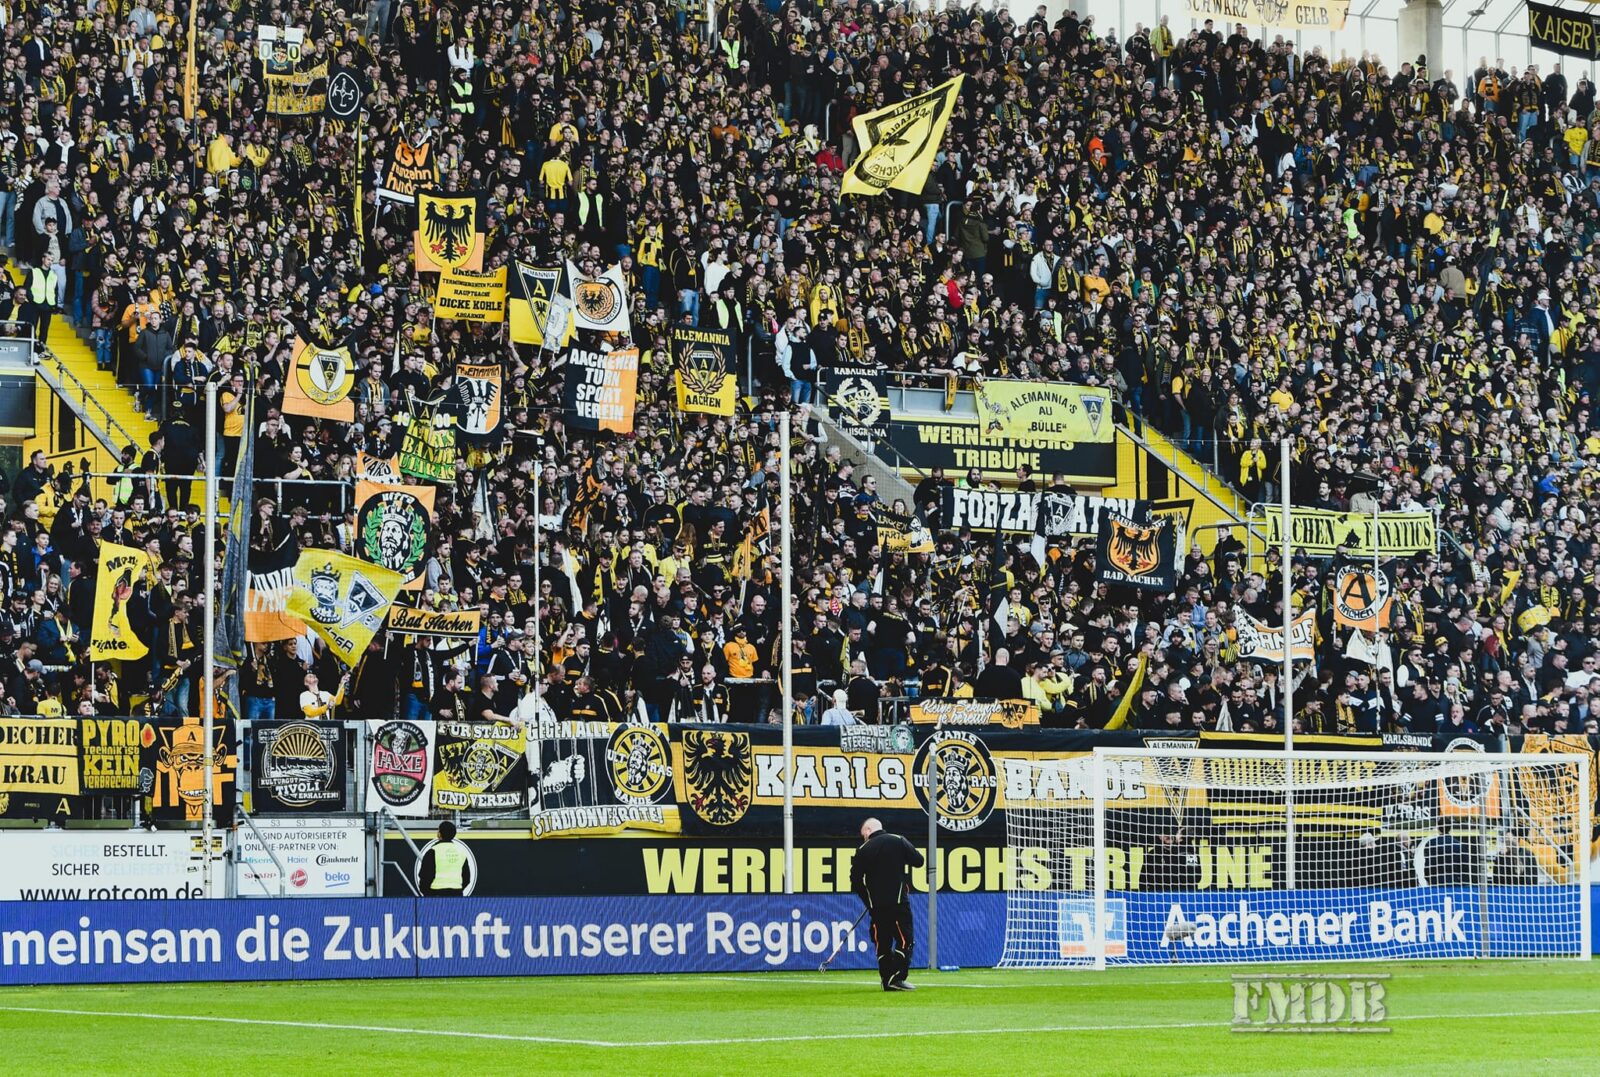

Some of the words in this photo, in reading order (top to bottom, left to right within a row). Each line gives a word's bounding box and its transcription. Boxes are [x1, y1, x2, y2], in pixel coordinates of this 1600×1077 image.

[1296, 5, 1329, 25] GELB
[1529, 10, 1592, 50] KAISER
[533, 280, 547, 297] A
[440, 297, 471, 309] DICKE
[473, 301, 502, 311] KOHLE
[674, 329, 731, 346] ALEMANNIA
[569, 348, 639, 370] AACHENER
[585, 367, 621, 387] TURN
[834, 367, 878, 377] RABAUKEN
[576, 383, 622, 404] SPORT
[685, 395, 721, 408] AACHEN
[575, 400, 624, 422] VEREIN
[1038, 407, 1053, 416] AU
[1089, 402, 1098, 412] A
[953, 448, 1041, 471] TRIBÜNE
[952, 488, 1039, 531] FORZA
[1269, 515, 1335, 546] ACHEN
[1103, 570, 1124, 580] BAD
[1125, 575, 1164, 586] AACHEN
[392, 609, 426, 627] Bad
[425, 614, 473, 631] Aachen
[82, 720, 140, 747] PYRO
[187, 731, 196, 742] A
[473, 725, 519, 740] STADT
[526, 721, 573, 741] GEGEN
[578, 722, 609, 739] ALLE
[934, 731, 979, 745] KARLS
[1152, 741, 1193, 749] ALEMANNIA
[83, 755, 140, 776] KEIN
[377, 750, 424, 773] FAXE
[3, 765, 66, 785] KRAU
[755, 753, 907, 799] KARLS
[275, 781, 320, 797] TIVOLI
[438, 790, 468, 806] UND
[469, 792, 521, 807] VEREIN
[56, 797, 71, 816] A
[533, 805, 664, 837] STADIONVERBOTE!
[938, 816, 983, 831] BANDE
[263, 832, 282, 840] SIND
[284, 831, 347, 840] AUTORISIERTER
[104, 844, 168, 857] BESTELLT.
[319, 856, 358, 864] Bauknecht
[51, 863, 99, 876] SICHER
[325, 872, 350, 881] beko
[904, 846, 1052, 893] UCHS
[1160, 899, 1358, 949] Aachener
[1370, 896, 1467, 944] Bank
[3, 916, 221, 966] meinsam
[236, 914, 310, 964] die
[323, 912, 510, 961] Zukunft
[523, 922, 695, 958] unserer
[706, 909, 868, 965] Region.
